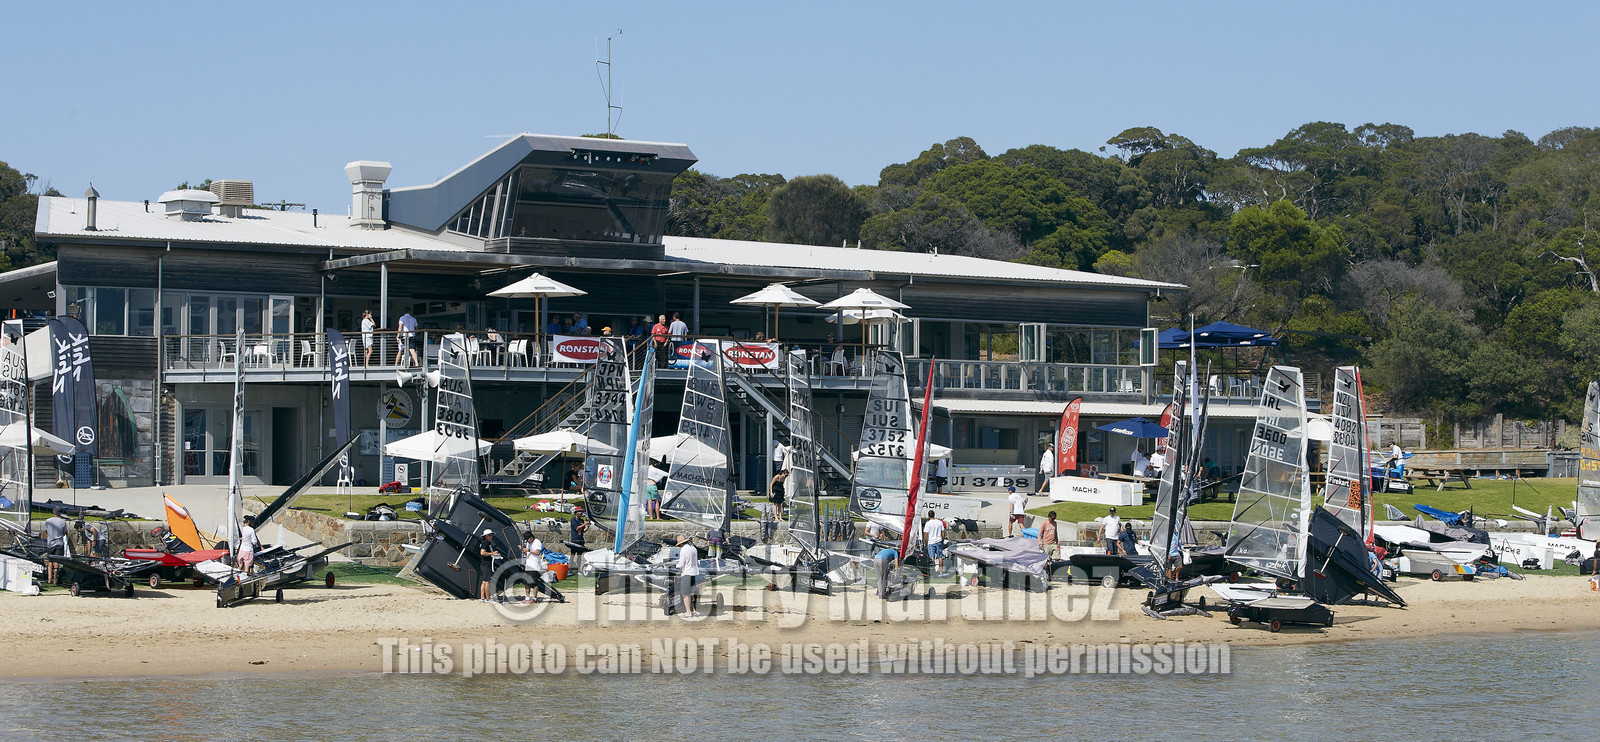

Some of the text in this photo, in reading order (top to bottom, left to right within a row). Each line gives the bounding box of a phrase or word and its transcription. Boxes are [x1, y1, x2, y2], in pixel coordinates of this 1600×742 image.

[559, 344, 608, 354] RONSTAN
[728, 350, 773, 359] RONSTAN
[3, 351, 25, 371] AUS
[599, 364, 624, 376] JPN
[441, 378, 463, 393] AUS
[596, 392, 625, 405] 3744
[1264, 394, 1281, 411] IRL
[1336, 391, 1351, 407] NZL
[874, 400, 898, 412] SUI
[438, 408, 470, 425] 3803
[1335, 418, 1357, 434] 4082
[869, 429, 904, 442] 3752
[1257, 426, 1287, 445] 3600
[972, 477, 1029, 488] 3798
[1072, 486, 1092, 494] MACH
[1494, 544, 1516, 553] MACH
